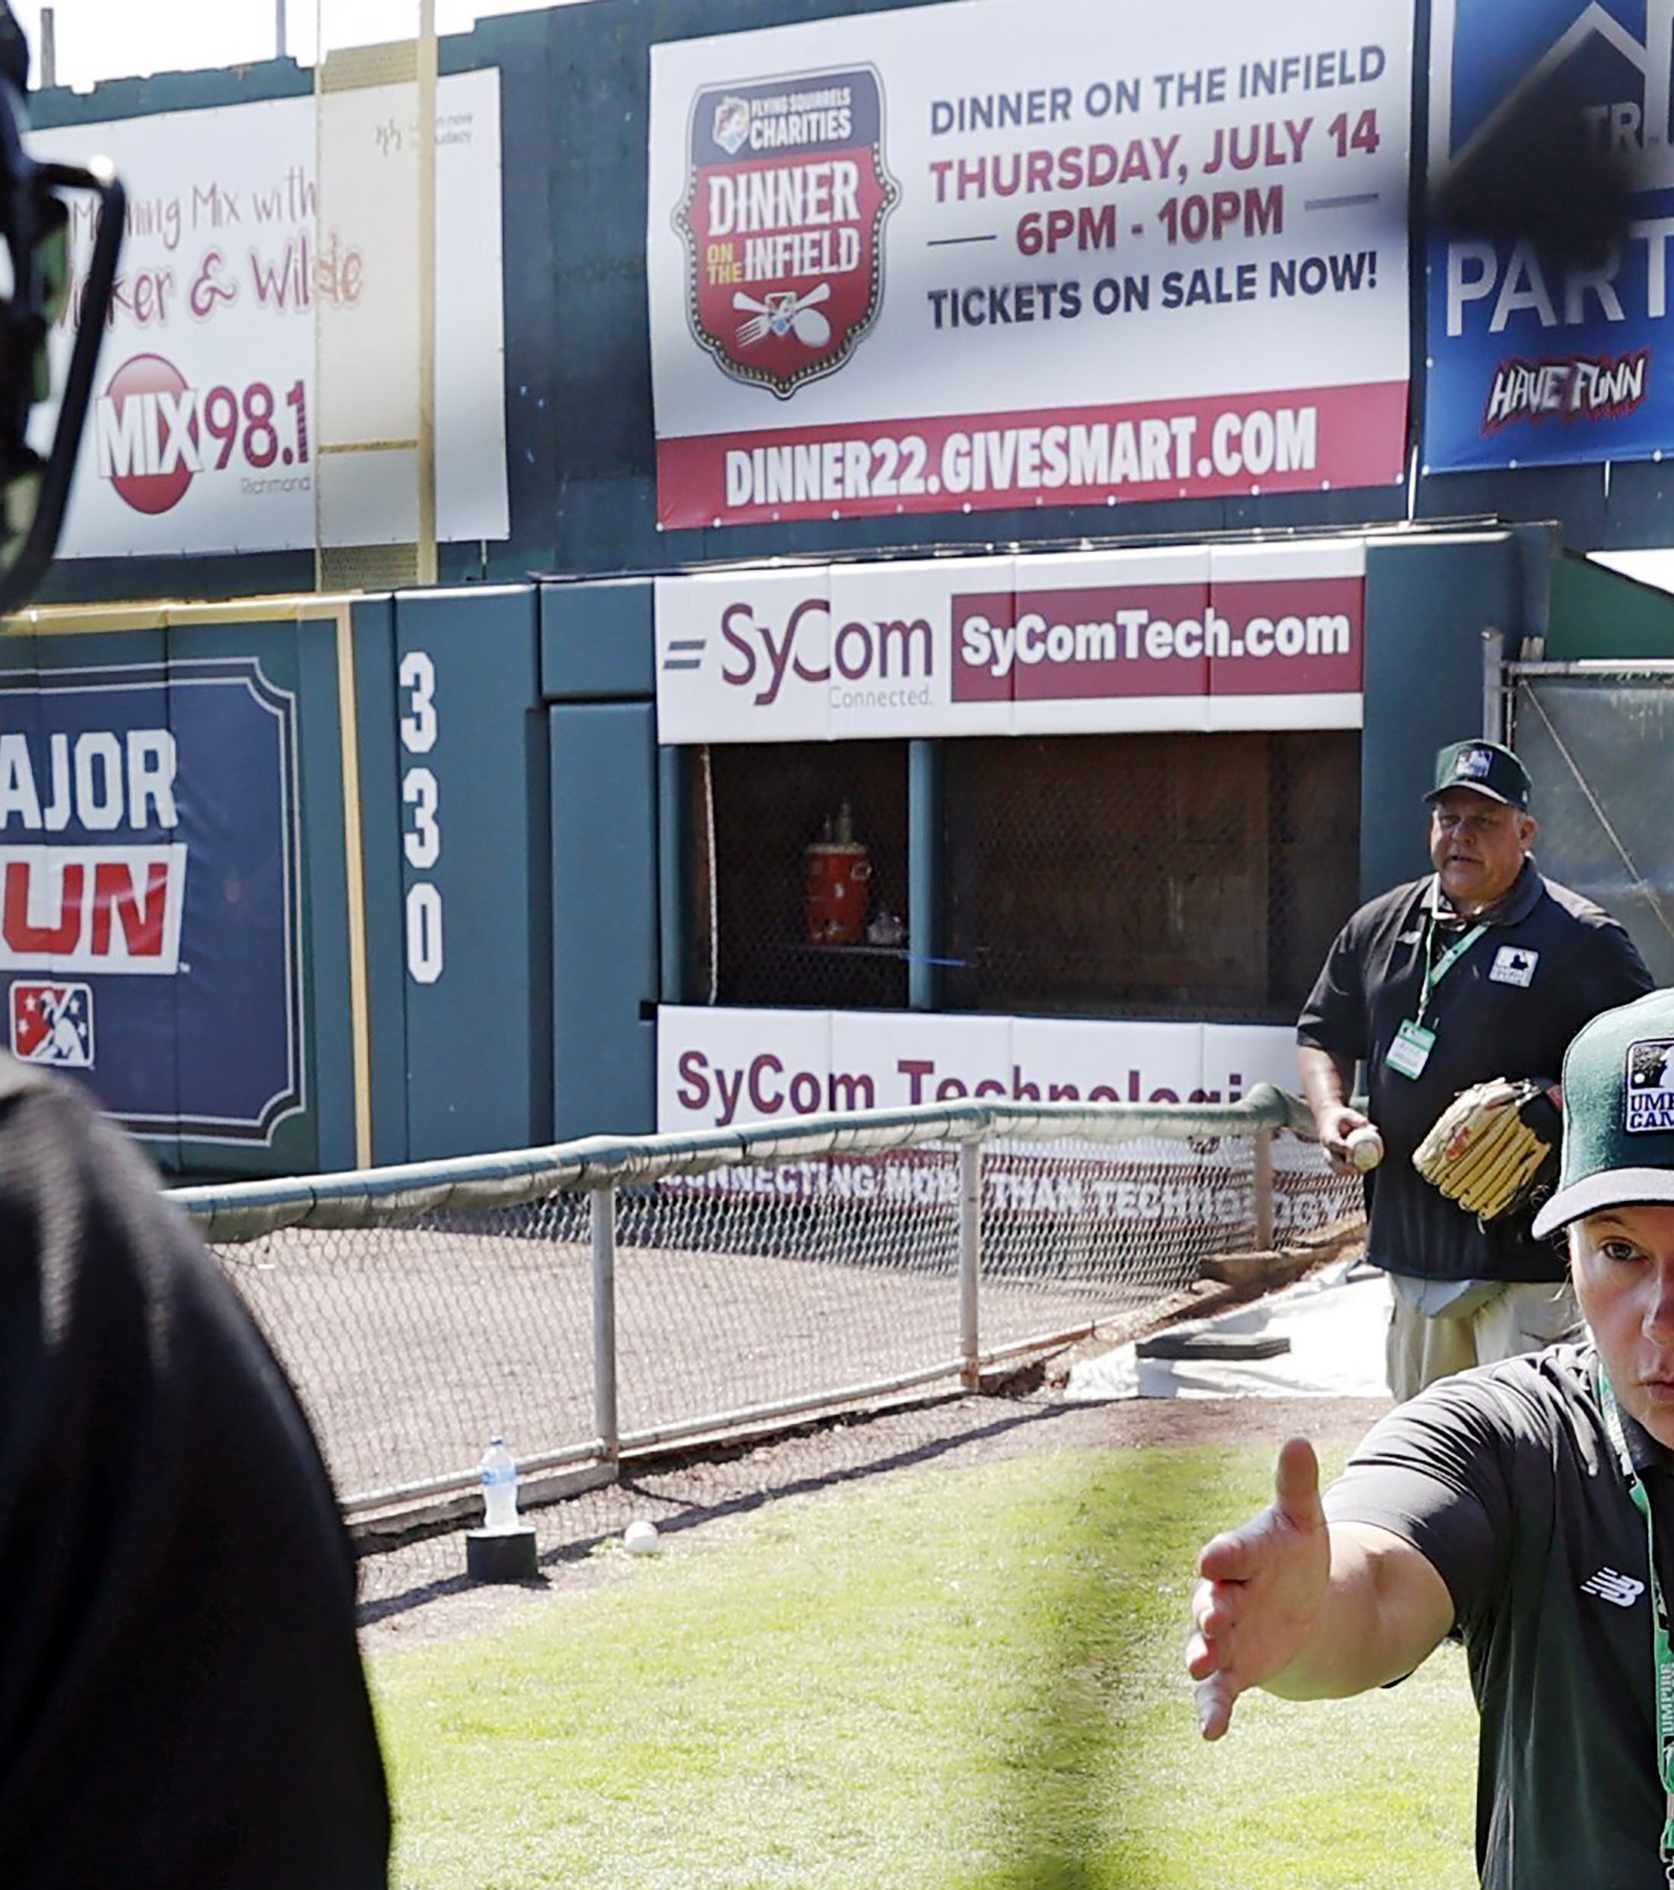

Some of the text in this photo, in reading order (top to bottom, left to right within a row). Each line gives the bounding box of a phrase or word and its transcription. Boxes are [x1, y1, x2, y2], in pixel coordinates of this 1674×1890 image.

[931, 45, 1386, 135] DINNER ON THE INFIELD
[750, 108, 852, 150] CHARITIES
[929, 109, 1380, 202] THURSDAY, JULY 14
[192, 182, 241, 229] Mix
[253, 166, 316, 222] with
[708, 161, 861, 236] DINNER
[1016, 205, 1117, 257] 6PM
[1157, 185, 1284, 246] 10PM
[190, 252, 235, 317] &
[250, 230, 363, 308] Wilde
[707, 242, 734, 265] ON
[707, 227, 861, 286] THE INFIELD
[927, 251, 1377, 330] TICKETS ON SALE NOW!
[1487, 357, 1646, 423] HAVE FUNN
[97, 380, 309, 478] MIX 98.1
[726, 406, 1317, 508] DINNER22.GIVESMART.COM
[722, 598, 1351, 706] SyCom SyComTech.com
[677, 1050, 876, 1128] SyCom
[660, 1162, 877, 1198] NNECTING
[884, 1165, 961, 1204] MOR
